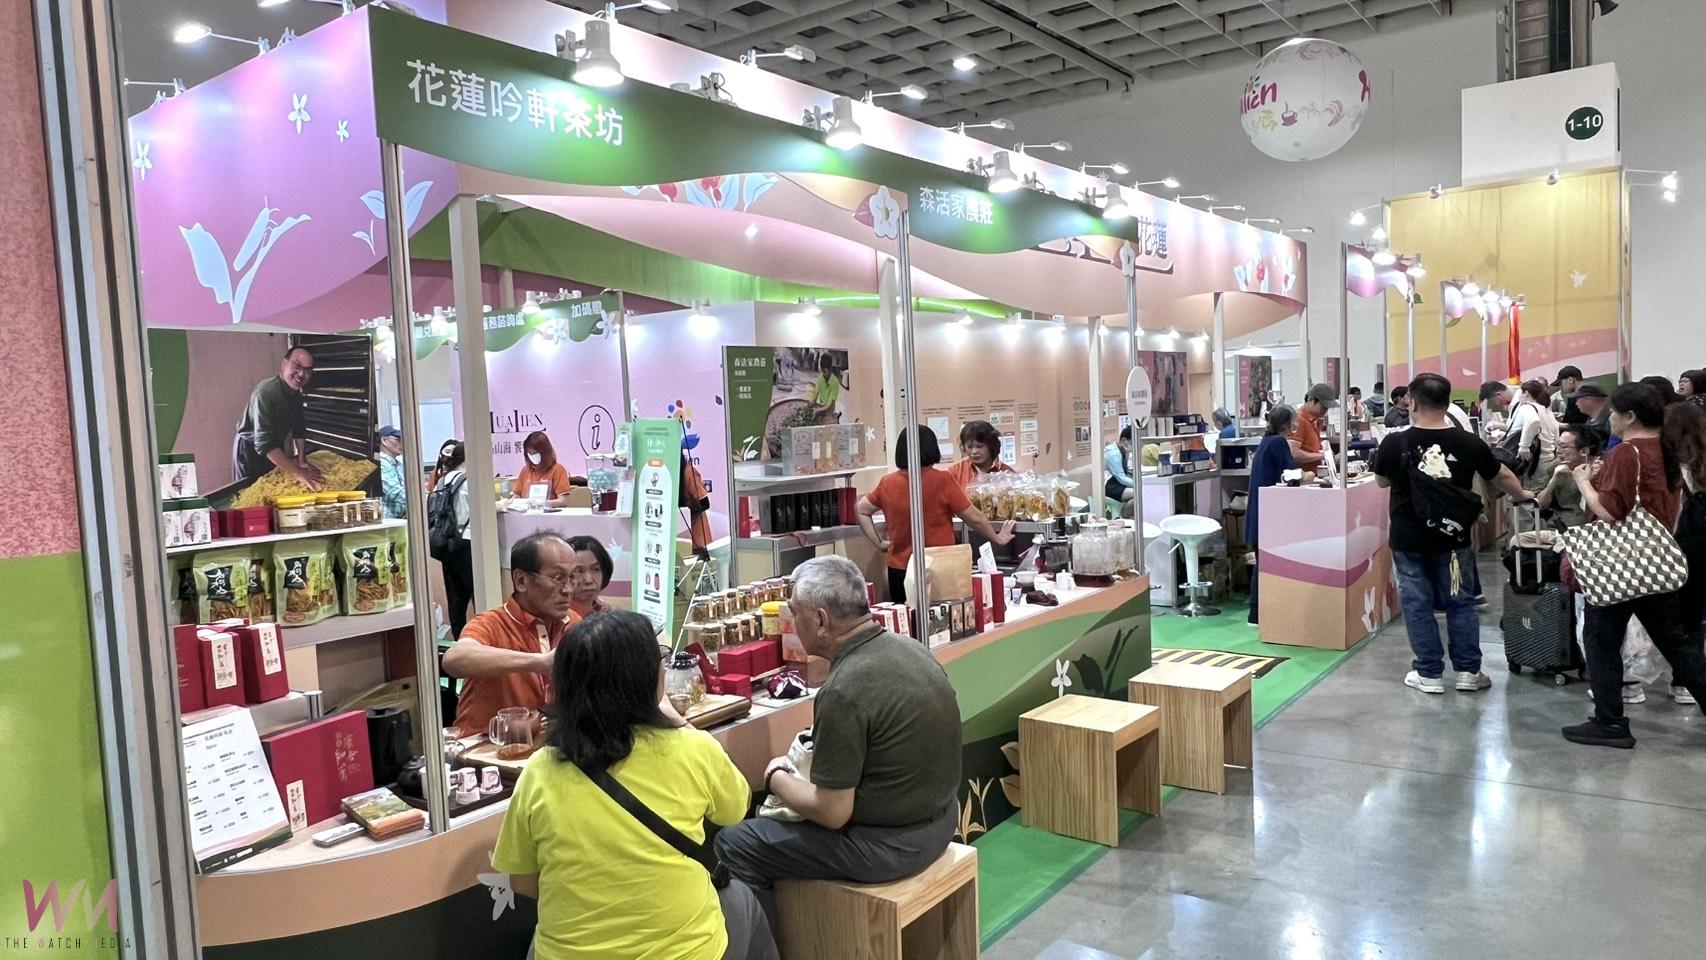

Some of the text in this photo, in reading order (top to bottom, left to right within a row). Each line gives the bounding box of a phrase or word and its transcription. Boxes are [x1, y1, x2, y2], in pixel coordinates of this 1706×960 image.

[406, 59, 624, 146] 花蓮吟軒茶坊
[1241, 82, 1277, 114] lien
[1567, 114, 1602, 131] 1-10
[919, 185, 993, 225] 森活家農莊
